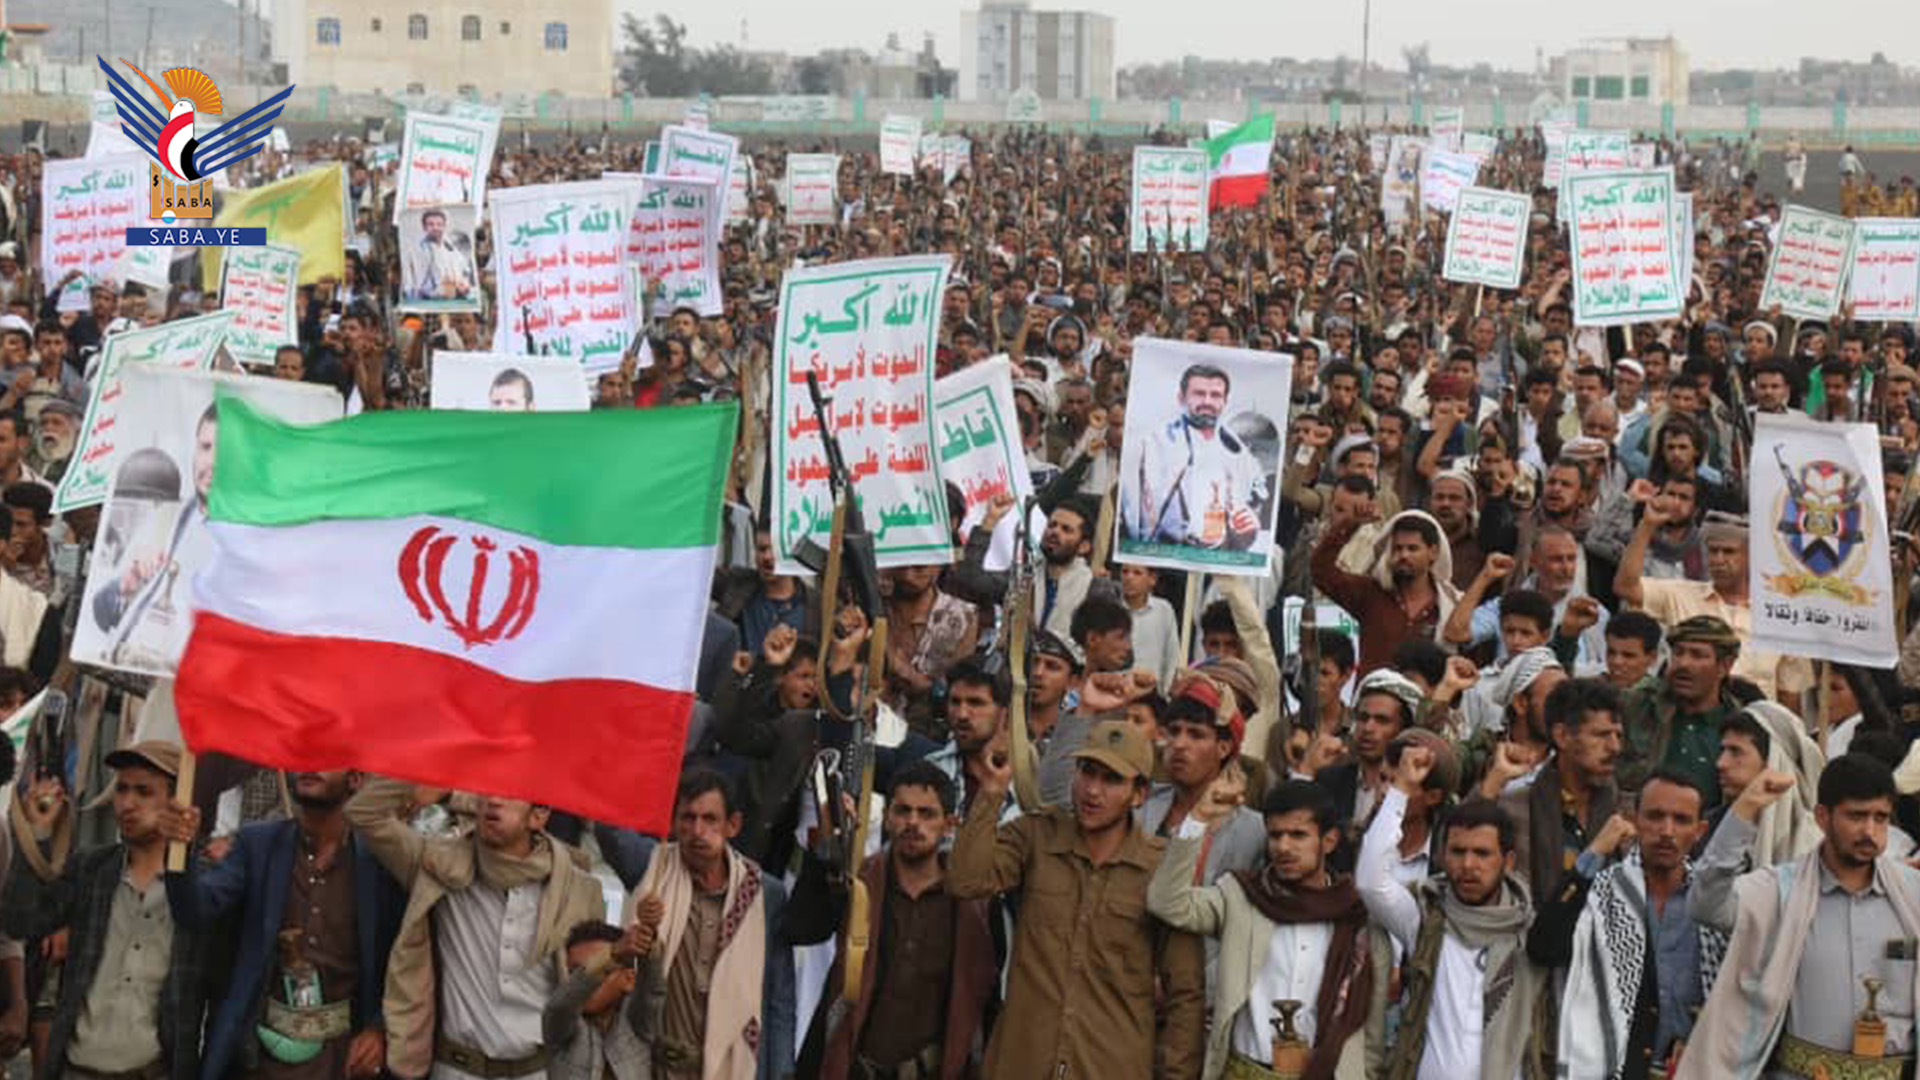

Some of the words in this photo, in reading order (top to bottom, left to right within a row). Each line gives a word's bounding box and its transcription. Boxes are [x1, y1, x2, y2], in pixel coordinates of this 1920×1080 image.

[637, 186, 669, 209] أك
[1632, 182, 1665, 202] الله
[508, 202, 574, 247] أكبر
[578, 204, 622, 232] الله
[790, 280, 881, 349] أكبر
[884, 282, 930, 325] الله
[788, 343, 865, 390] لأمريكا
[872, 343, 925, 384] الموت
[871, 393, 925, 433] الموت
[941, 407, 996, 463] قاط
[787, 453, 831, 488] يهود
[848, 446, 879, 483] على
[887, 442, 931, 473] اللعنة
[874, 485, 941, 540] النصر
